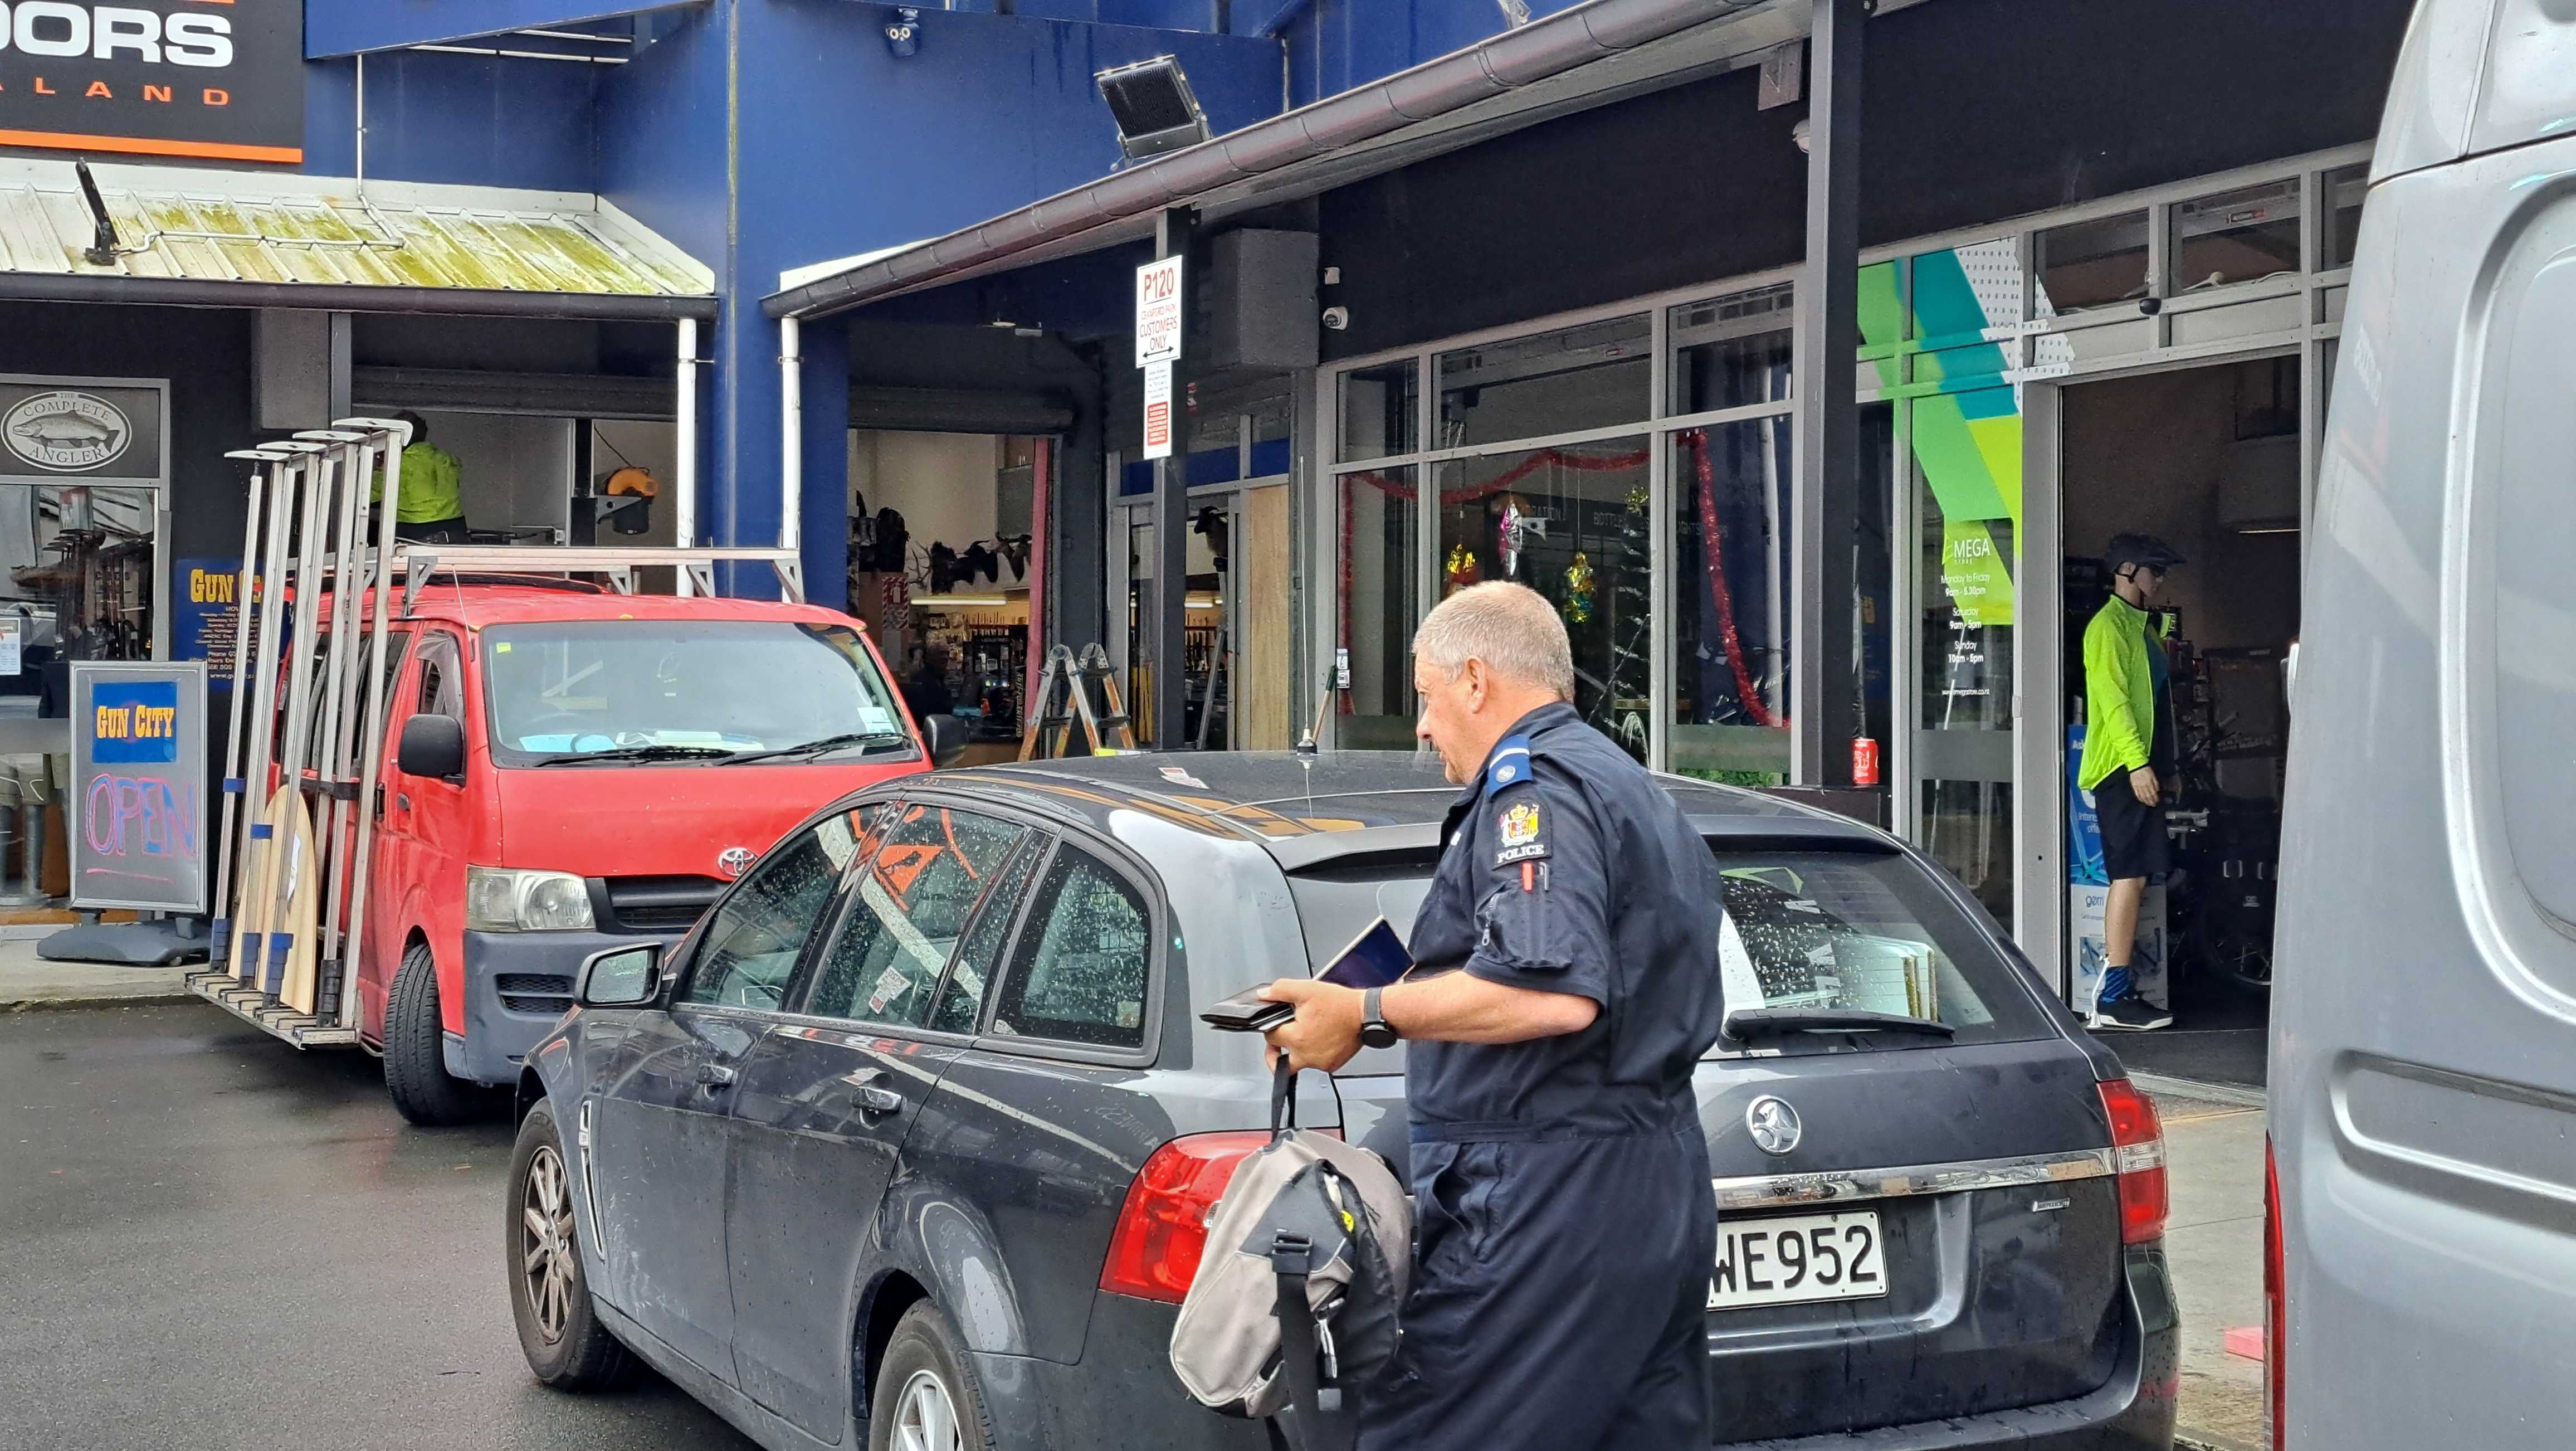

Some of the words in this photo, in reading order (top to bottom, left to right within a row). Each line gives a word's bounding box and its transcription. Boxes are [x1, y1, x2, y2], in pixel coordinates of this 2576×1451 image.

[0, 1, 233, 67] ORS
[0, 77, 231, 106] LAND
[1144, 267, 1174, 302] P120
[1140, 315, 1177, 338] CUSTOMERS
[1150, 334, 1167, 351] ONLY
[23, 401, 111, 420] COMPLETE
[29, 446, 105, 463] ANGLER
[1954, 538, 1990, 558] MEGA
[191, 568, 234, 603] GUN
[1941, 574, 1965, 585] Monday
[1966, 574, 1972, 582] to
[1973, 573, 1991, 583] Friday
[1953, 607, 1979, 616] Saturday
[1968, 620, 1982, 630] 5pm
[1954, 641, 1977, 651] Sunday
[1948, 654, 1965, 663] 10am
[1970, 654, 1984, 664] 5pm
[96, 705, 129, 738] GUN
[135, 705, 174, 738] CITY
[86, 773, 199, 856] OPEN
[1497, 844, 1545, 864] POLICE
[1709, 1224, 1878, 1294] WE952
